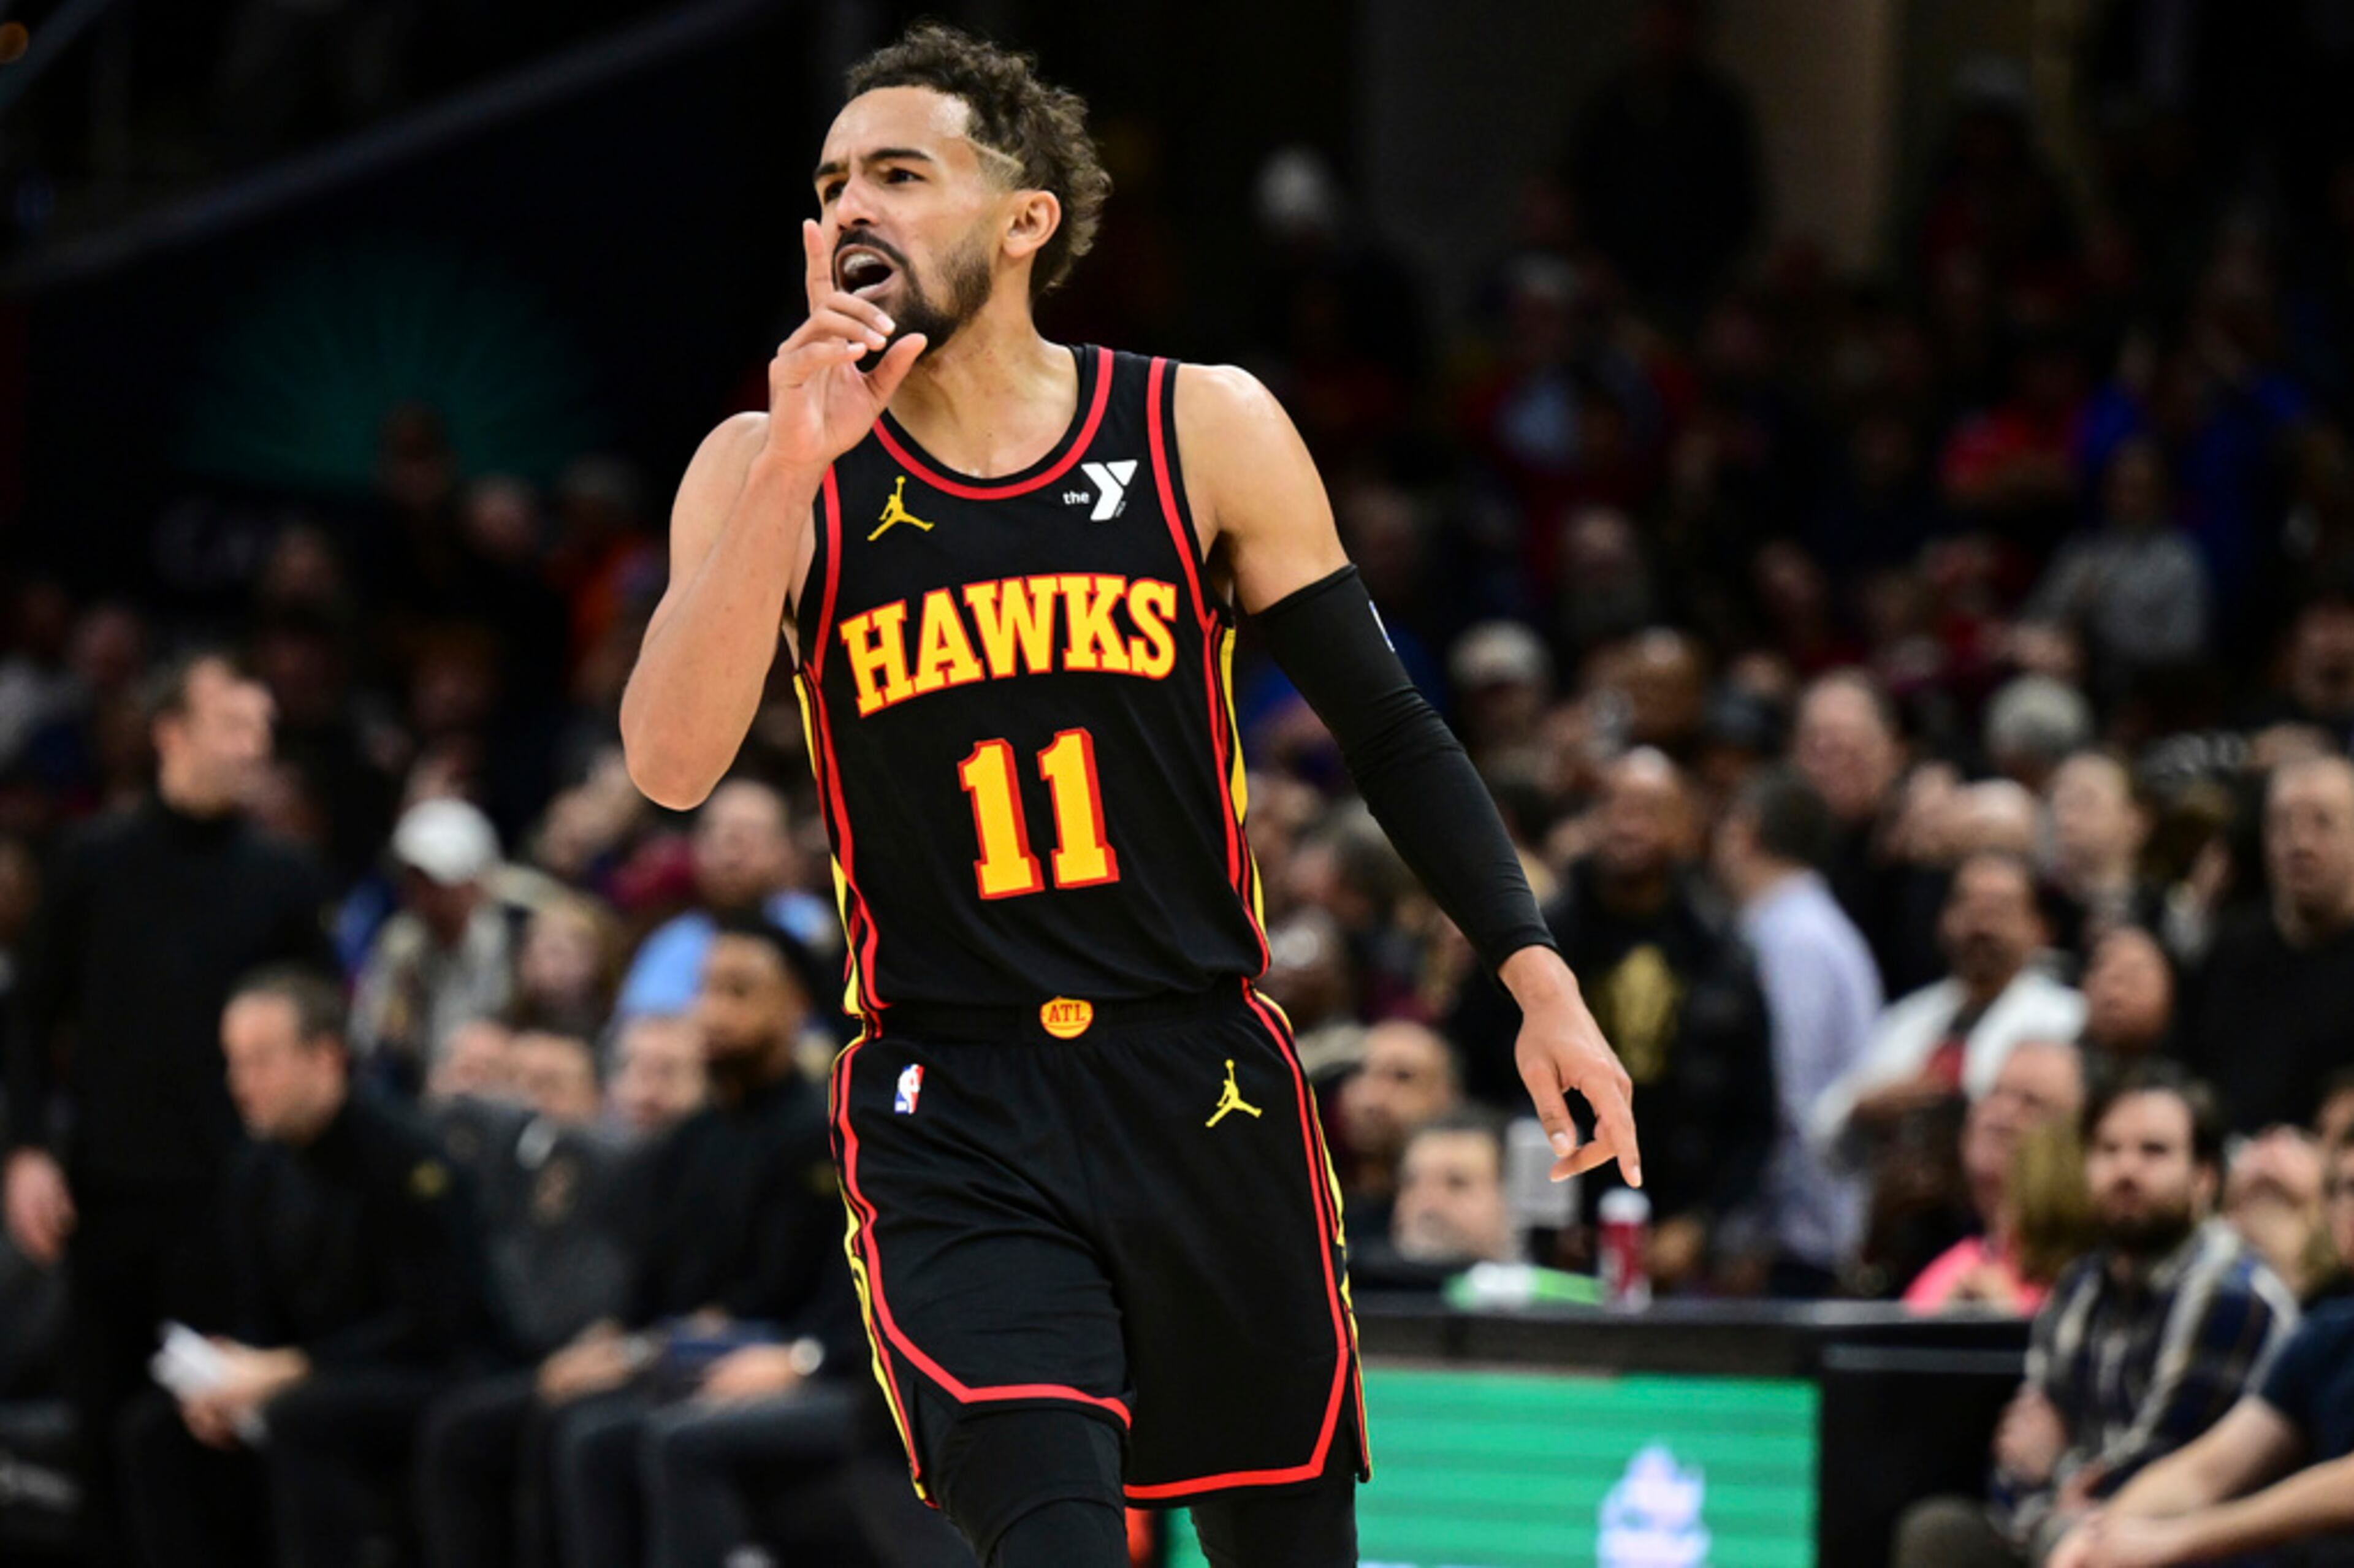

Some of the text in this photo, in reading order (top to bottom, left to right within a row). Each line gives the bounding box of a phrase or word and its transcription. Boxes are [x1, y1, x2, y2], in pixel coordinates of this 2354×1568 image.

[1062, 491, 1089, 504] the
[839, 573, 1176, 718] HAWKS
[958, 728, 1119, 899] 11
[1049, 1004, 1086, 1022] ATL
